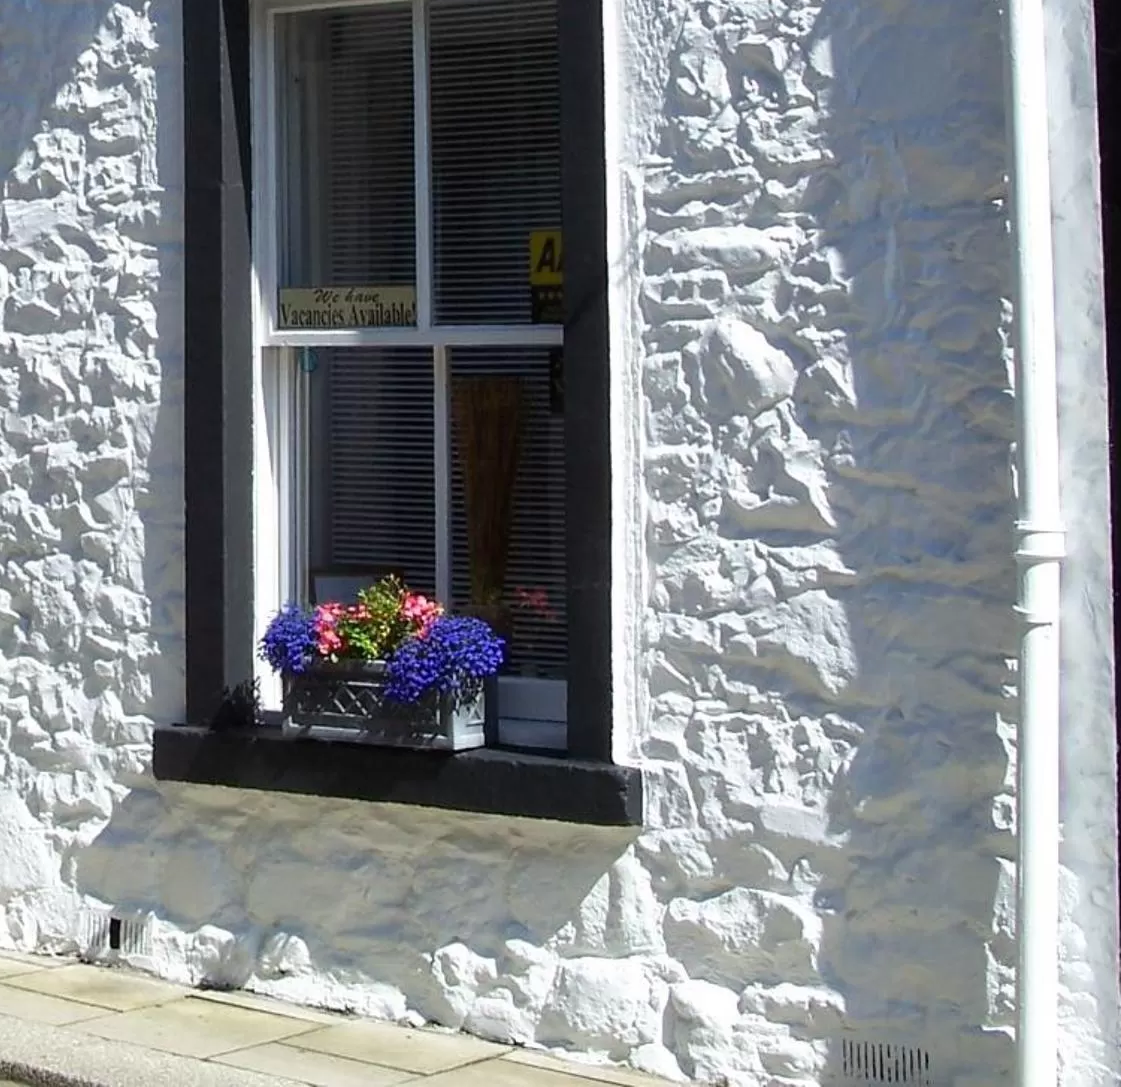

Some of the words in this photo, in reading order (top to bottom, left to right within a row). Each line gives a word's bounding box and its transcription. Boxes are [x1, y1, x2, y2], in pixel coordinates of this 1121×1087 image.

[536, 238, 562, 272] A
[314, 288, 340, 304] We
[344, 287, 381, 303] have
[280, 303, 345, 326] Vacancies
